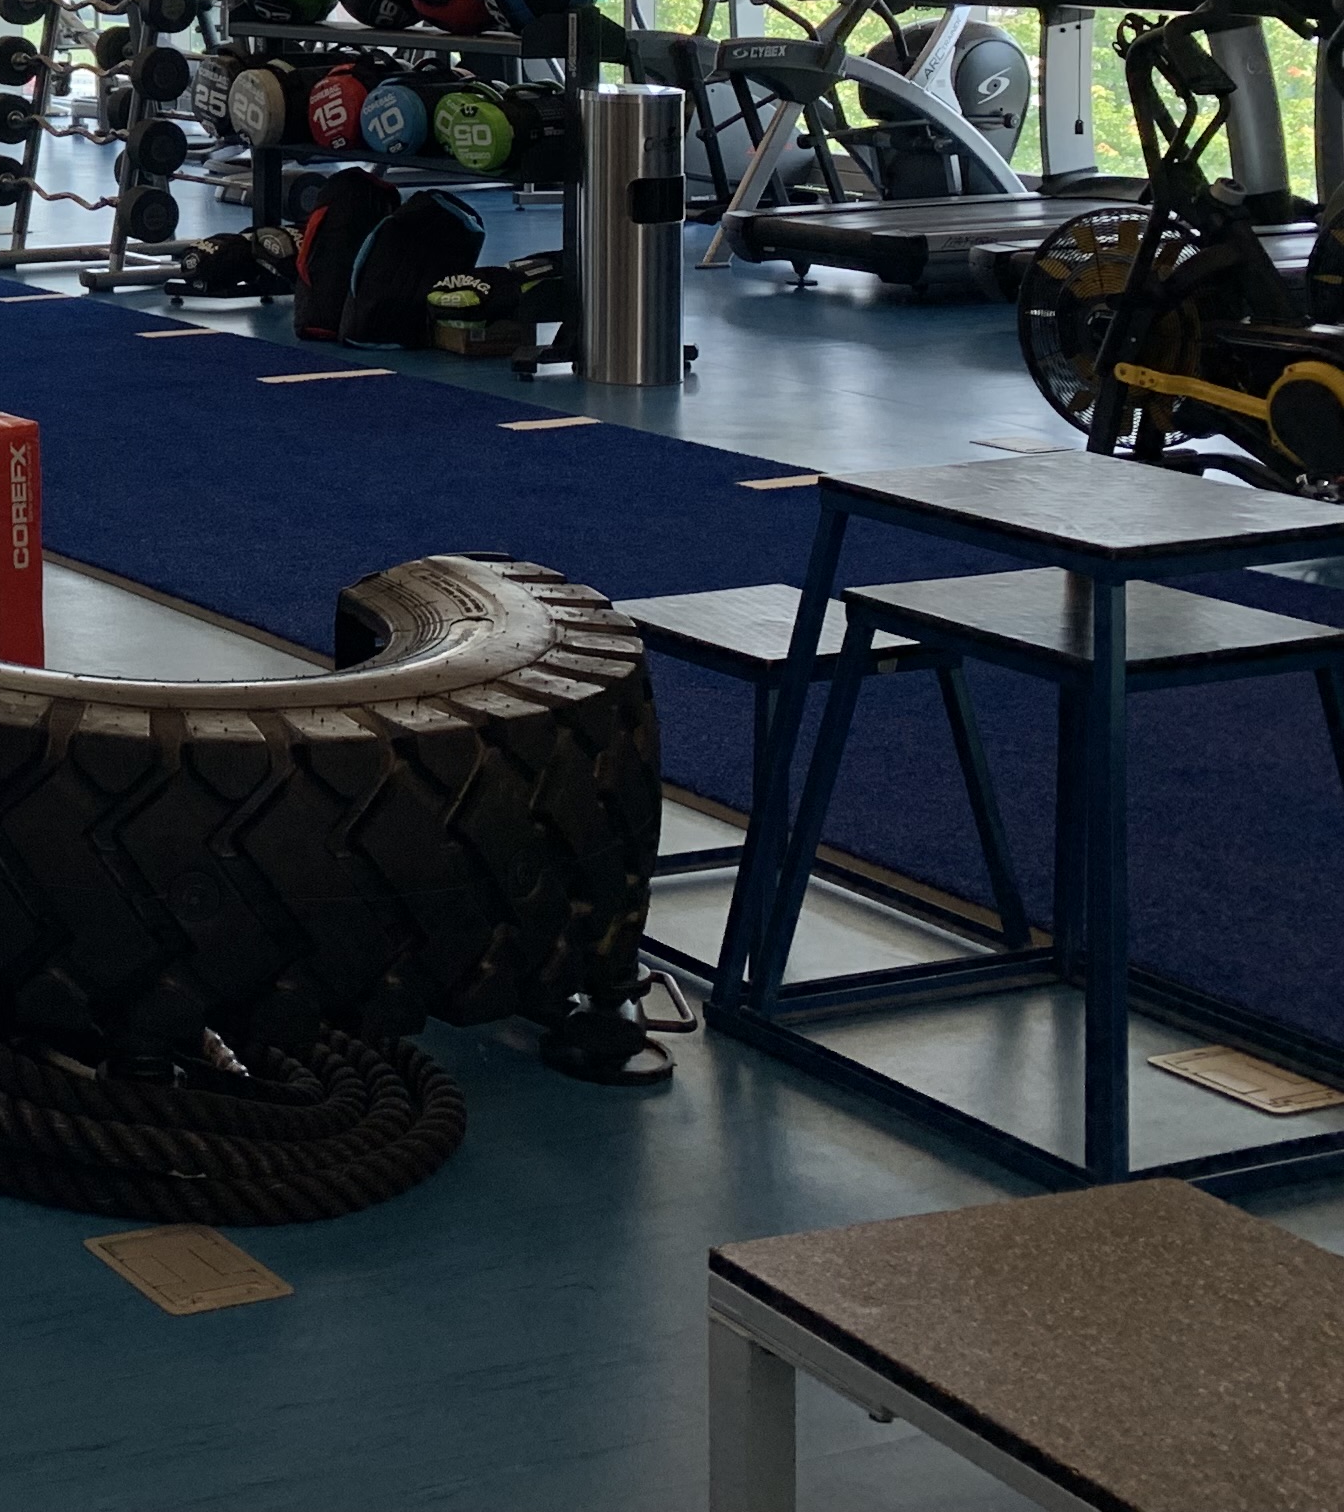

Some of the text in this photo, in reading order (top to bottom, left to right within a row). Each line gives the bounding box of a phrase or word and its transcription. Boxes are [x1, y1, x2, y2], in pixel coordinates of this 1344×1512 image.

[749, 45, 787, 58] CYBEX
[194, 84, 227, 118] 25
[233, 92, 263, 131] 20
[313, 98, 348, 132] 15
[367, 106, 405, 139] 10
[441, 295, 461, 306] 22
[10, 442, 29, 569] COREFX
